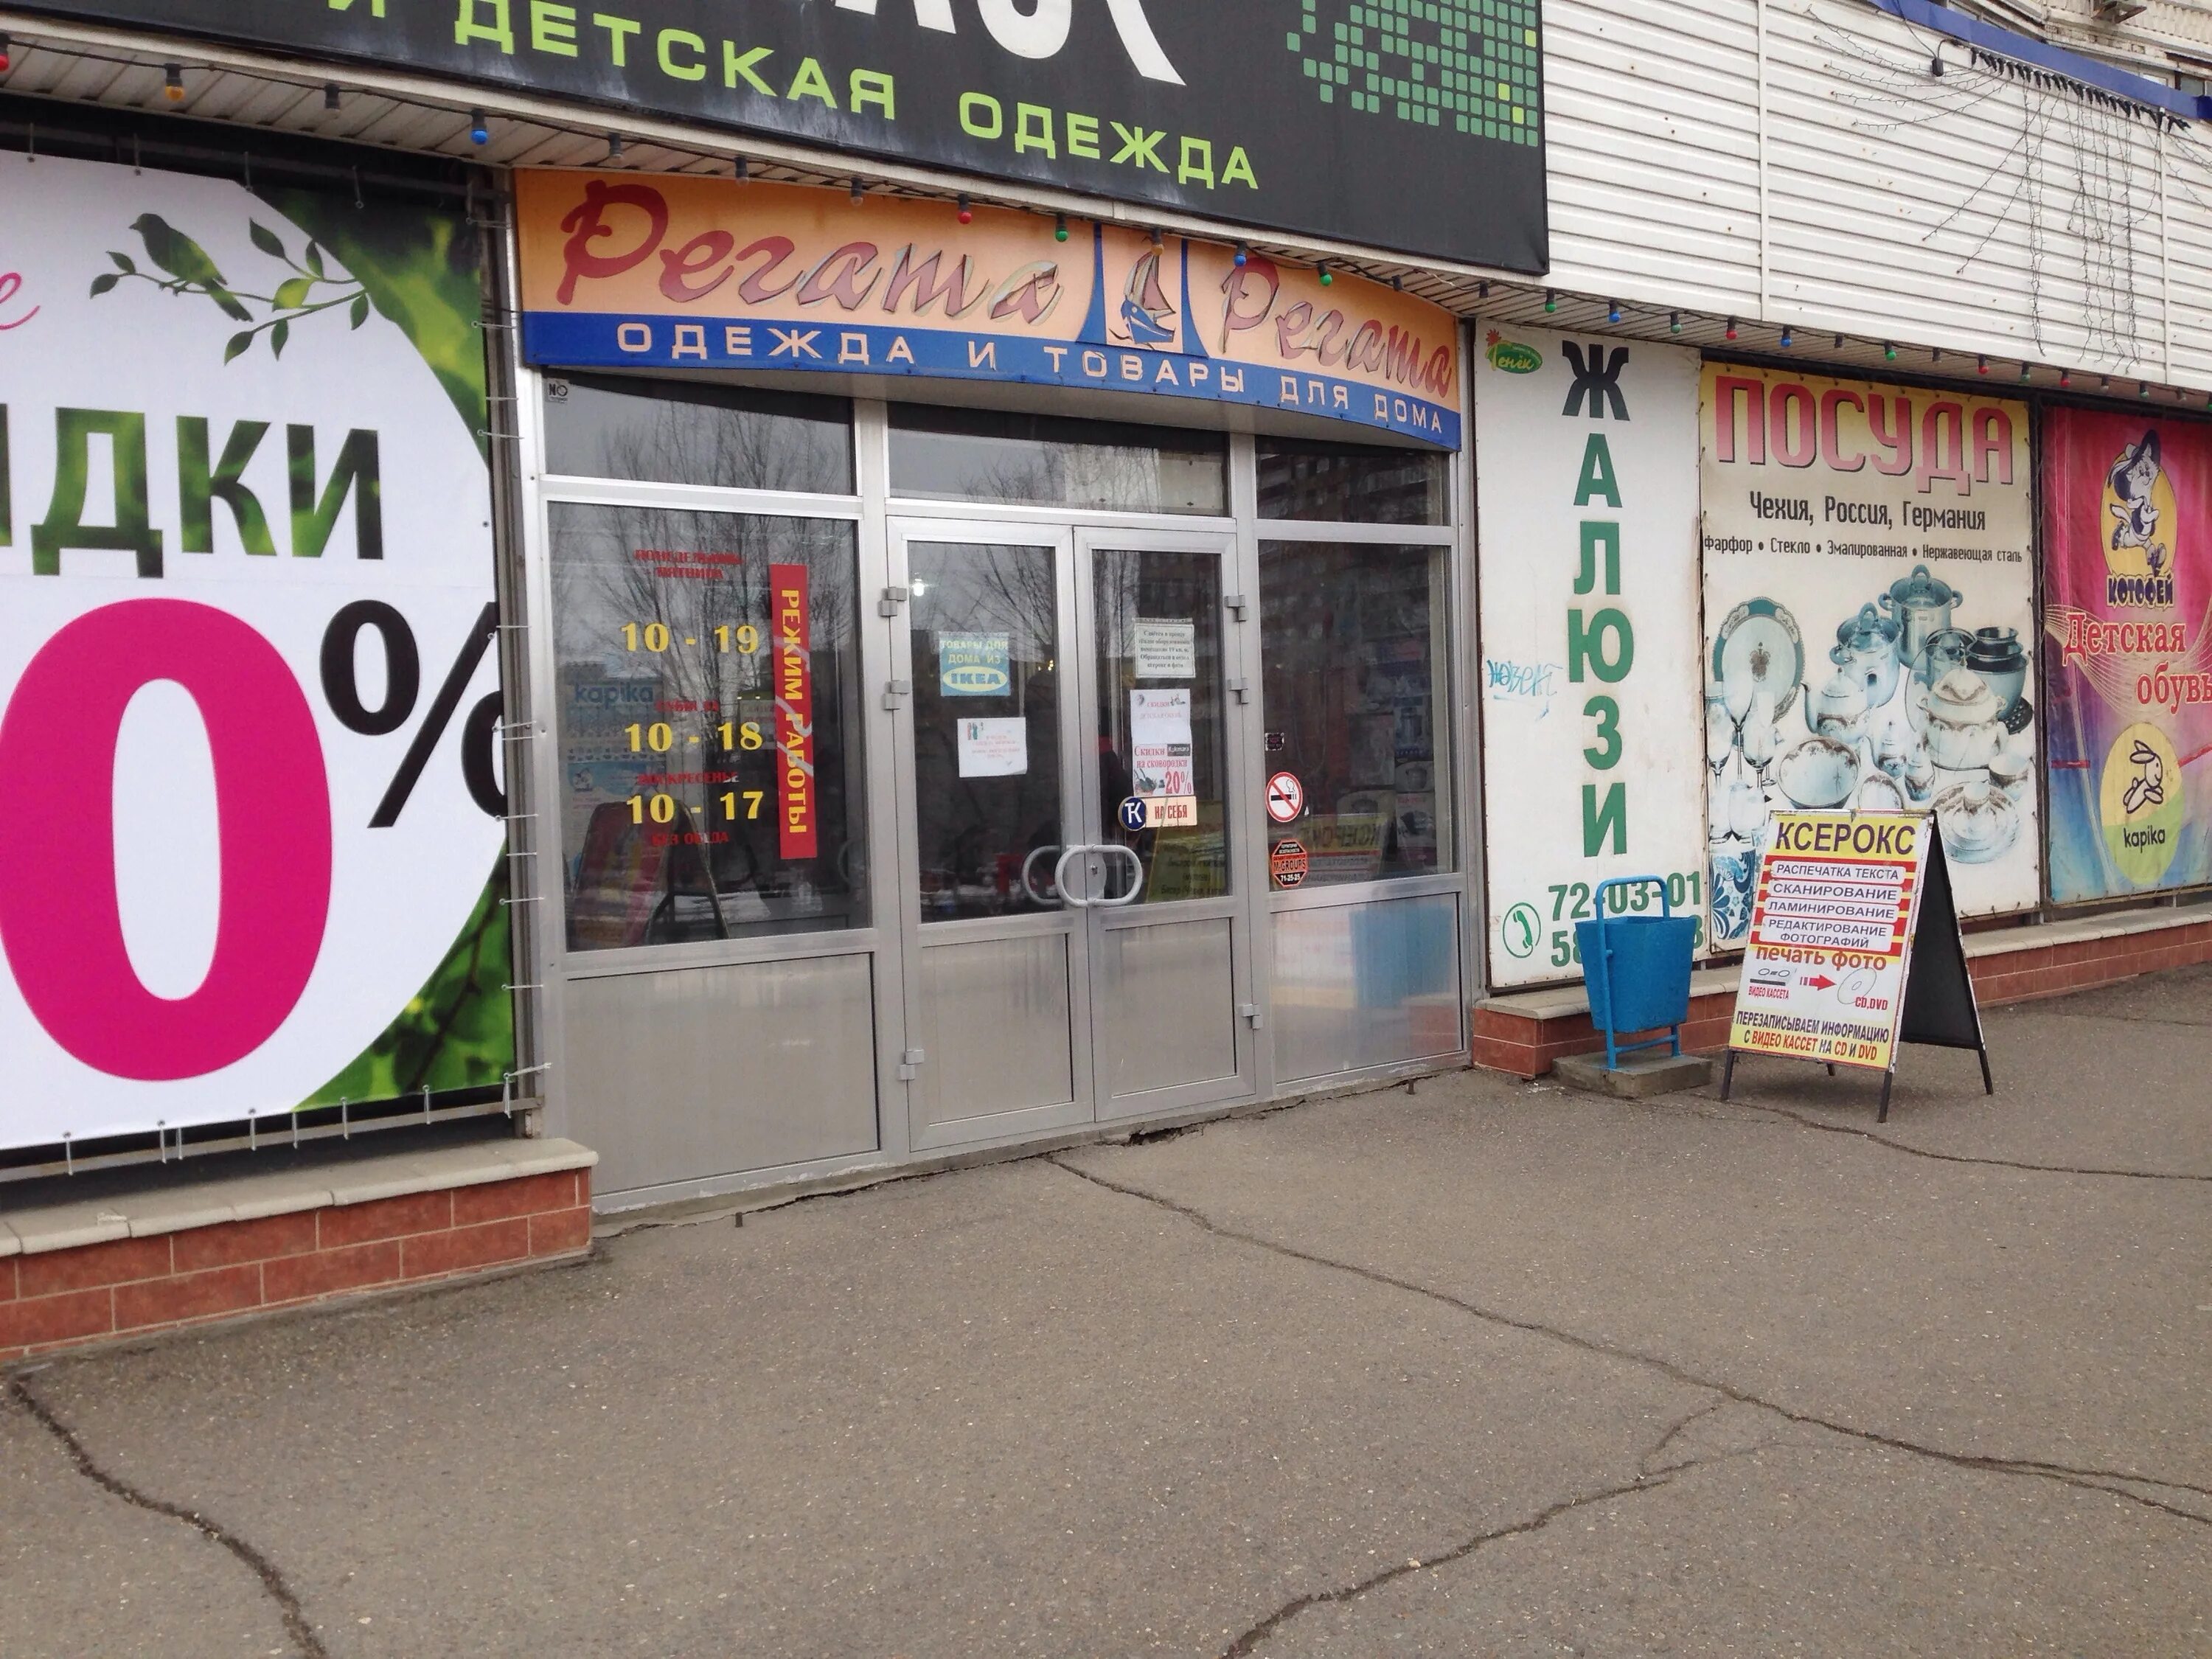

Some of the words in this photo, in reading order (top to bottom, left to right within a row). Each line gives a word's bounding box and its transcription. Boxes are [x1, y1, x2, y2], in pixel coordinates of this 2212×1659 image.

[455, 0, 896, 121] ДЕТСКАЯ
[959, 91, 1259, 190] ОДЕЖДА
[557, 179, 1063, 324] Регата
[1219, 257, 1453, 399] Регата
[616, 321, 915, 365] ОДЕЖДА
[967, 341, 996, 371] И
[1043, 346, 1244, 393] ТОВАРЫ
[1279, 375, 1349, 410] ДЛЯ
[1374, 394, 1442, 434] ДОМА
[1715, 375, 2014, 497] ПОСУДА
[0, 403, 383, 579] ДКИ
[1750, 490, 1814, 526] Чехия,
[1824, 495, 1893, 530] Россия,
[1902, 501, 1986, 532] Германия
[1770, 538, 1811, 554] Стекло
[1827, 540, 1907, 559] Эмалированная
[1922, 544, 1992, 563] Нержавеющая
[1997, 549, 2023, 563] сталь
[1561, 340, 1635, 858] ЖАЛЮЗИ
[2107, 573, 2174, 610] КОТОФЕЙ
[621, 622, 670, 653] 10
[714, 625, 759, 655] 19
[781, 588, 804, 700] РЕЖИМ
[2062, 612, 2187, 667] Детская
[948, 654, 980, 664] ДОМА
[987, 655, 1001, 664] ИЗ
[950, 673, 1001, 685] IKEA
[2136, 661, 2212, 714] обувь
[574, 682, 654, 710] kapika
[624, 722, 673, 753] 10
[717, 721, 763, 751] 18
[1134, 746, 1165, 756] Скидки
[785, 713, 807, 833] РАБОТЫ
[1136, 760, 1145, 768] на
[1147, 759, 1187, 771] сковородки
[1165, 771, 1192, 794] 20%
[626, 793, 675, 824] 10
[719, 790, 764, 821] 17
[1167, 805, 1188, 818] СЕБЯ
[1775, 822, 1916, 855] КСЕРОКС
[2123, 824, 2166, 858] kapika
[1273, 859, 1306, 872] M-GROUPS
[1776, 864, 1851, 877] РАСПЕЧАТКА
[1855, 868, 1899, 880] ТЕКСТА
[1773, 883, 1897, 900] СКАНИРОВАНИЕ
[1768, 901, 1895, 919] ЛАМИНИРОВАНИЕ
[1768, 919, 1888, 937] РЕДАКТИРОВАНИЕ
[1780, 933, 1870, 948] ФОТОГРАФИЙ
[1756, 945, 1826, 966] печать
[1832, 950, 1888, 971] фото
[1748, 987, 1766, 998] ВИДЕО
[1766, 988, 1790, 1000] КАССЕТА
[1736, 1011, 1820, 1033] ПЕРЕЗАПИСЫВАЕМ
[1821, 1020, 1889, 1044] ИНФОРМАЦИЮ
[1744, 1029, 1750, 1044] С
[1751, 1030, 1781, 1048] ВИДЕО
[1782, 1034, 1818, 1053] КАССЕТ
[1818, 1039, 1832, 1054] НА
[1834, 1040, 1847, 1055] CD
[1848, 1043, 1856, 1058] И
[1857, 1044, 1877, 1061] DVD
